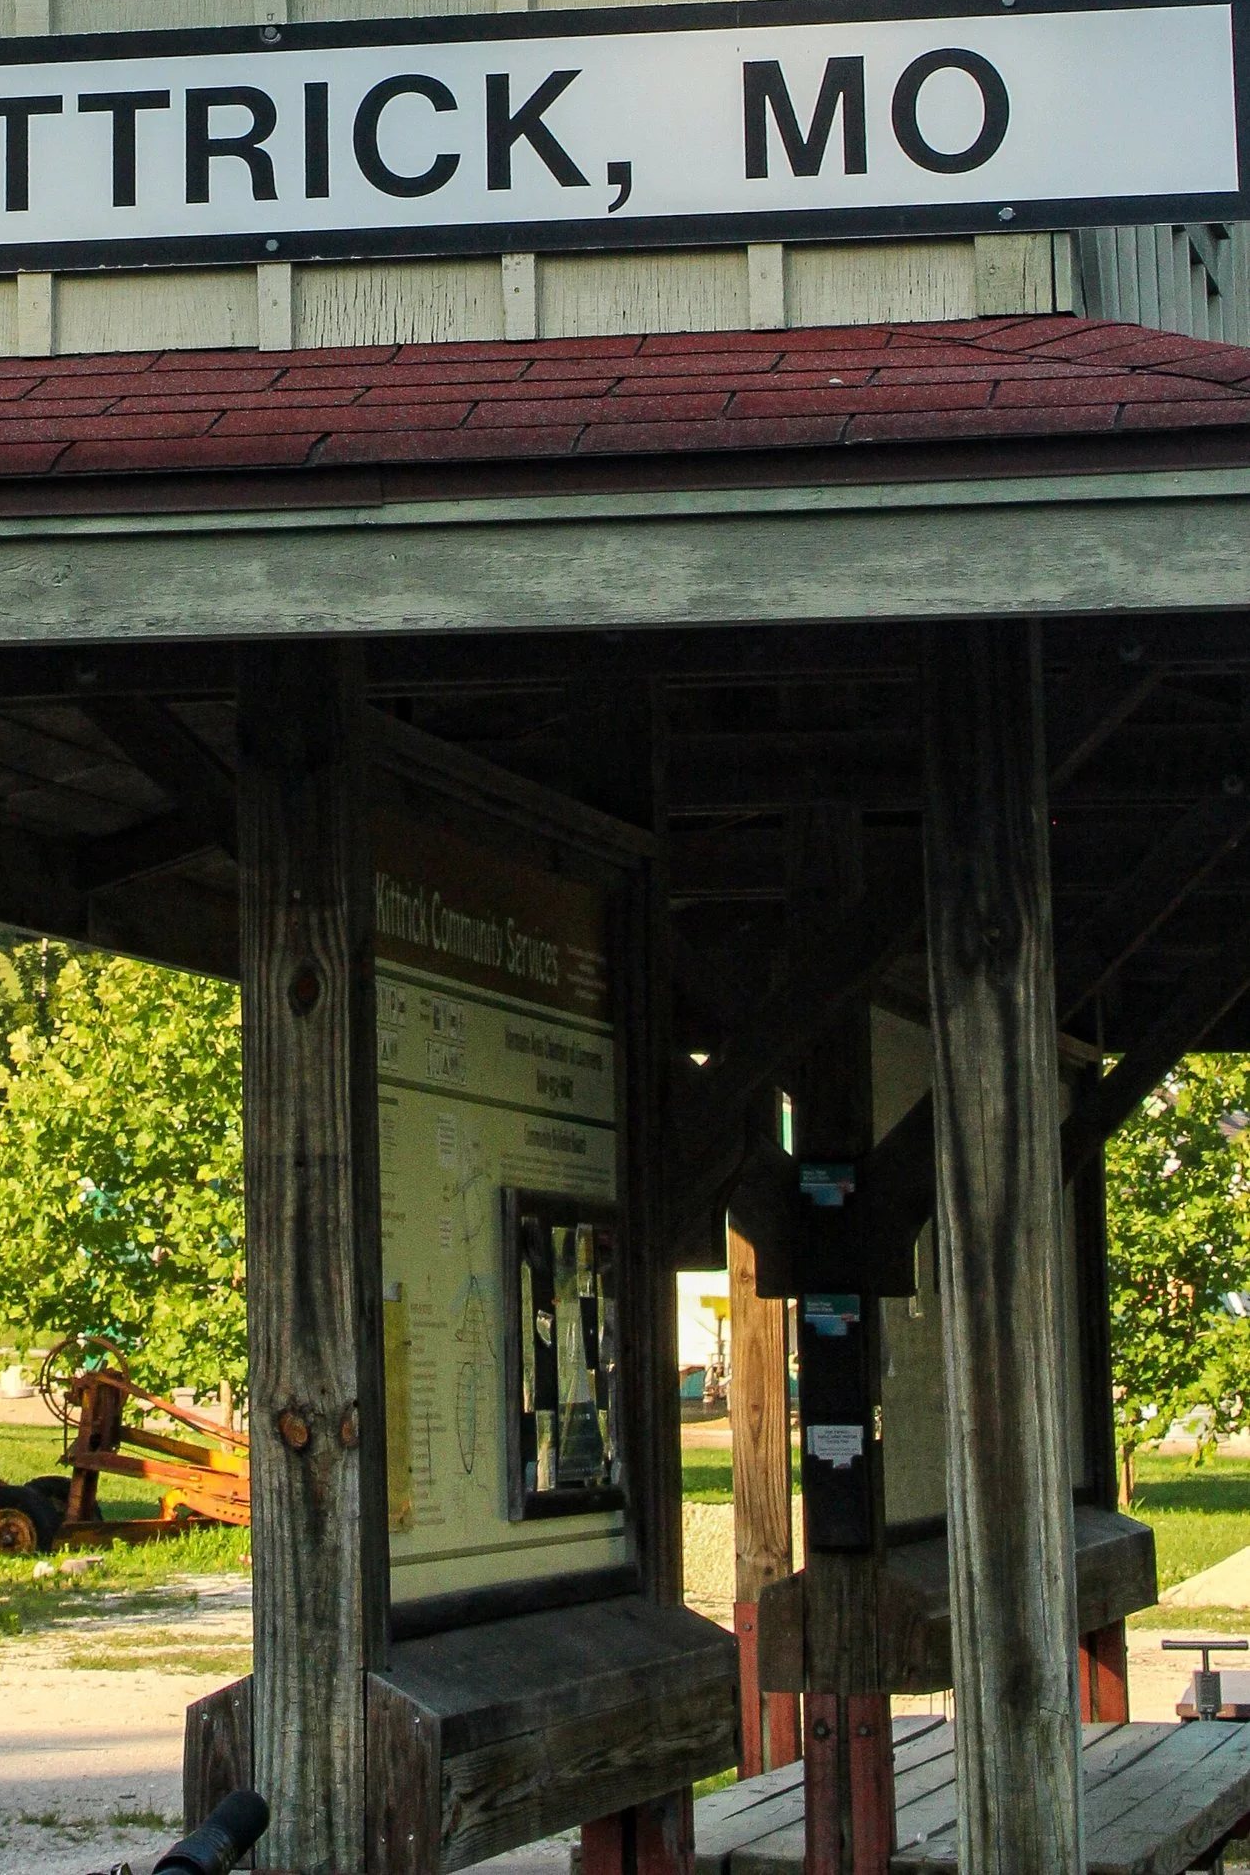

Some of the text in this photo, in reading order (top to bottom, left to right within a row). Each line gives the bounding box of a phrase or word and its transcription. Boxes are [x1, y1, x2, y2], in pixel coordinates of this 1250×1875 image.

[742, 47, 1010, 180] MO
[431, 891, 503, 967] Community
[506, 917, 561, 986] Services
